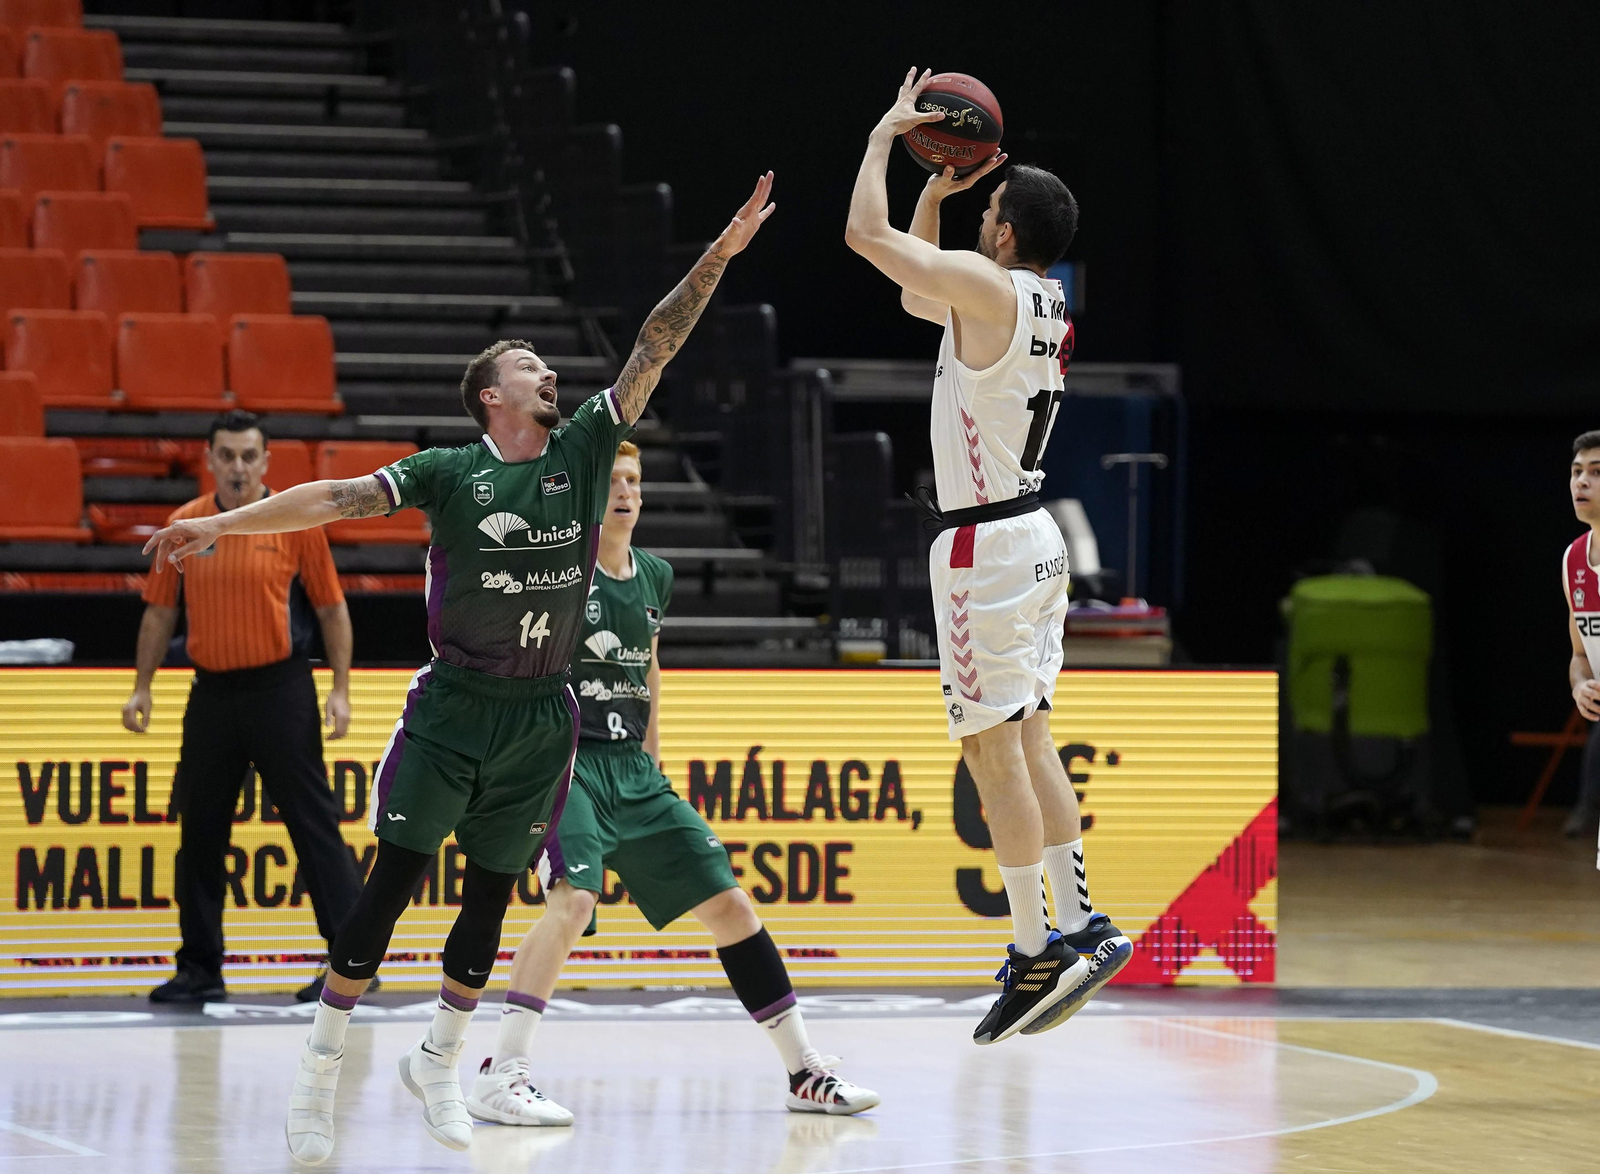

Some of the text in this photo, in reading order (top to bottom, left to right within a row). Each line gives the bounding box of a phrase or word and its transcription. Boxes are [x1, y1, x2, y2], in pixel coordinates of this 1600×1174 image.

[909, 128, 977, 160] SPALDING
[527, 520, 582, 543] Unicaja
[481, 564, 582, 594] 2020 MÁLAGA
[519, 610, 550, 648] 14
[16, 761, 178, 824] VUEL
[688, 745, 922, 831] MÁLAGA,
